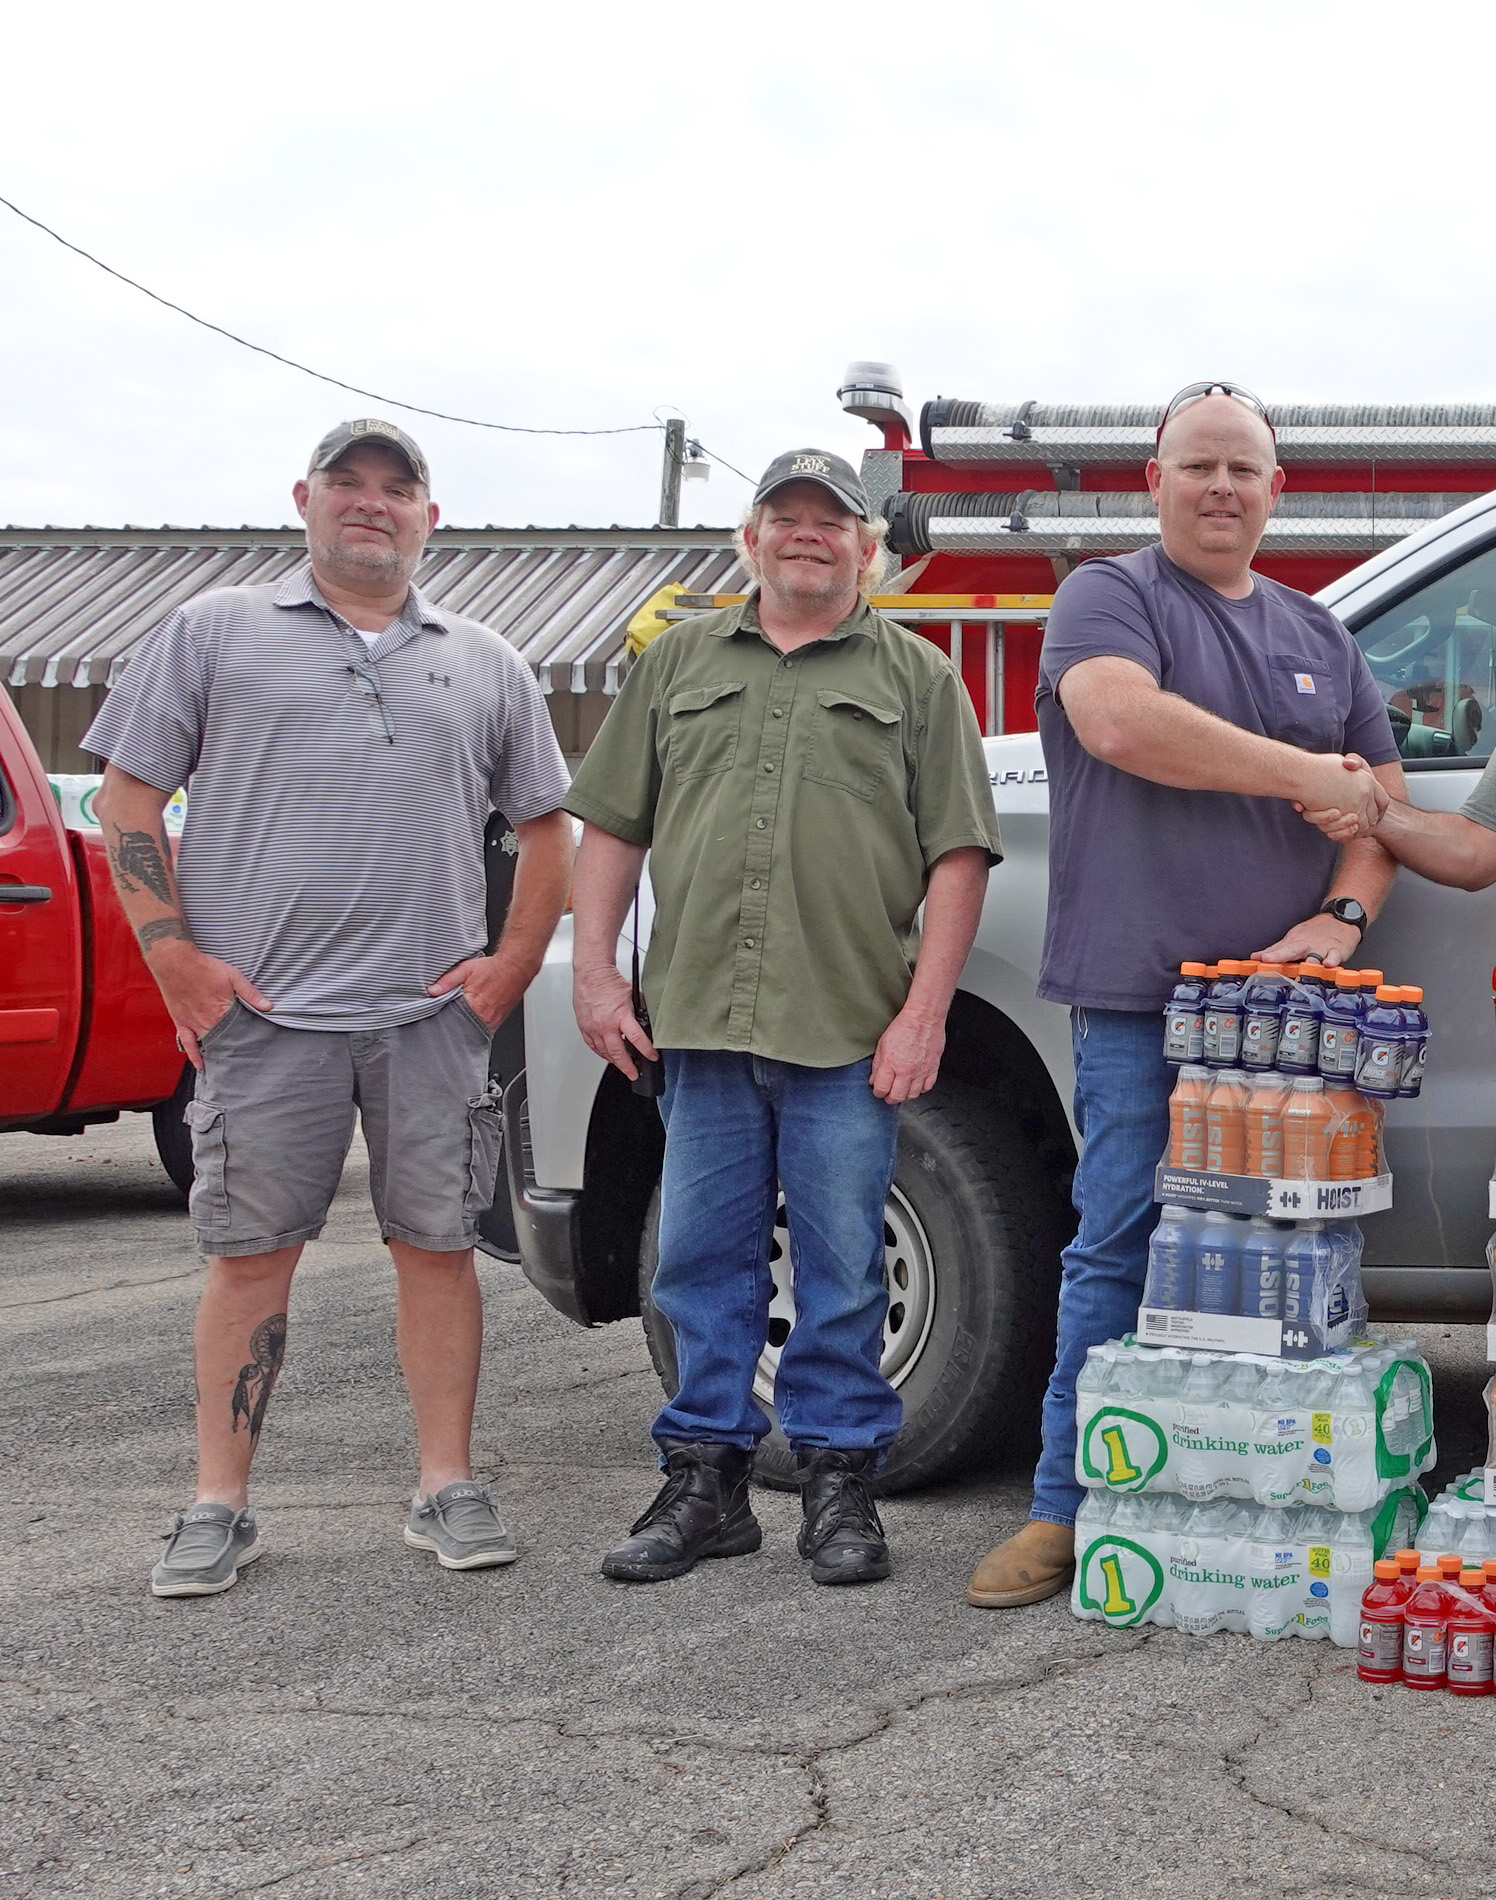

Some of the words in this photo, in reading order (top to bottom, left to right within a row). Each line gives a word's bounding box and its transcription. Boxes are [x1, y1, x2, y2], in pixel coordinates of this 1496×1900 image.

[1171, 1017, 1186, 1036] G
[1206, 1016, 1218, 1036] G
[1247, 1021, 1261, 1040] G
[1285, 1020, 1301, 1040] G
[1323, 1029, 1337, 1049] G
[1372, 1046, 1390, 1066] G
[1163, 1174, 1199, 1186] POWERFUL
[1172, 1423, 1199, 1435] purified
[1314, 1423, 1330, 1435] 40
[1172, 1431, 1249, 1456] drinking
[1254, 1440, 1304, 1455] water
[1101, 1424, 1142, 1486] 1
[1170, 1556, 1197, 1567] purified
[1311, 1557, 1331, 1569] 40
[1100, 1553, 1136, 1617] 1
[1169, 1563, 1245, 1589] drinking
[1251, 1573, 1300, 1589] water
[1360, 1623, 1373, 1644] G
[1407, 1629, 1423, 1651] G
[1453, 1636, 1469, 1657] G
